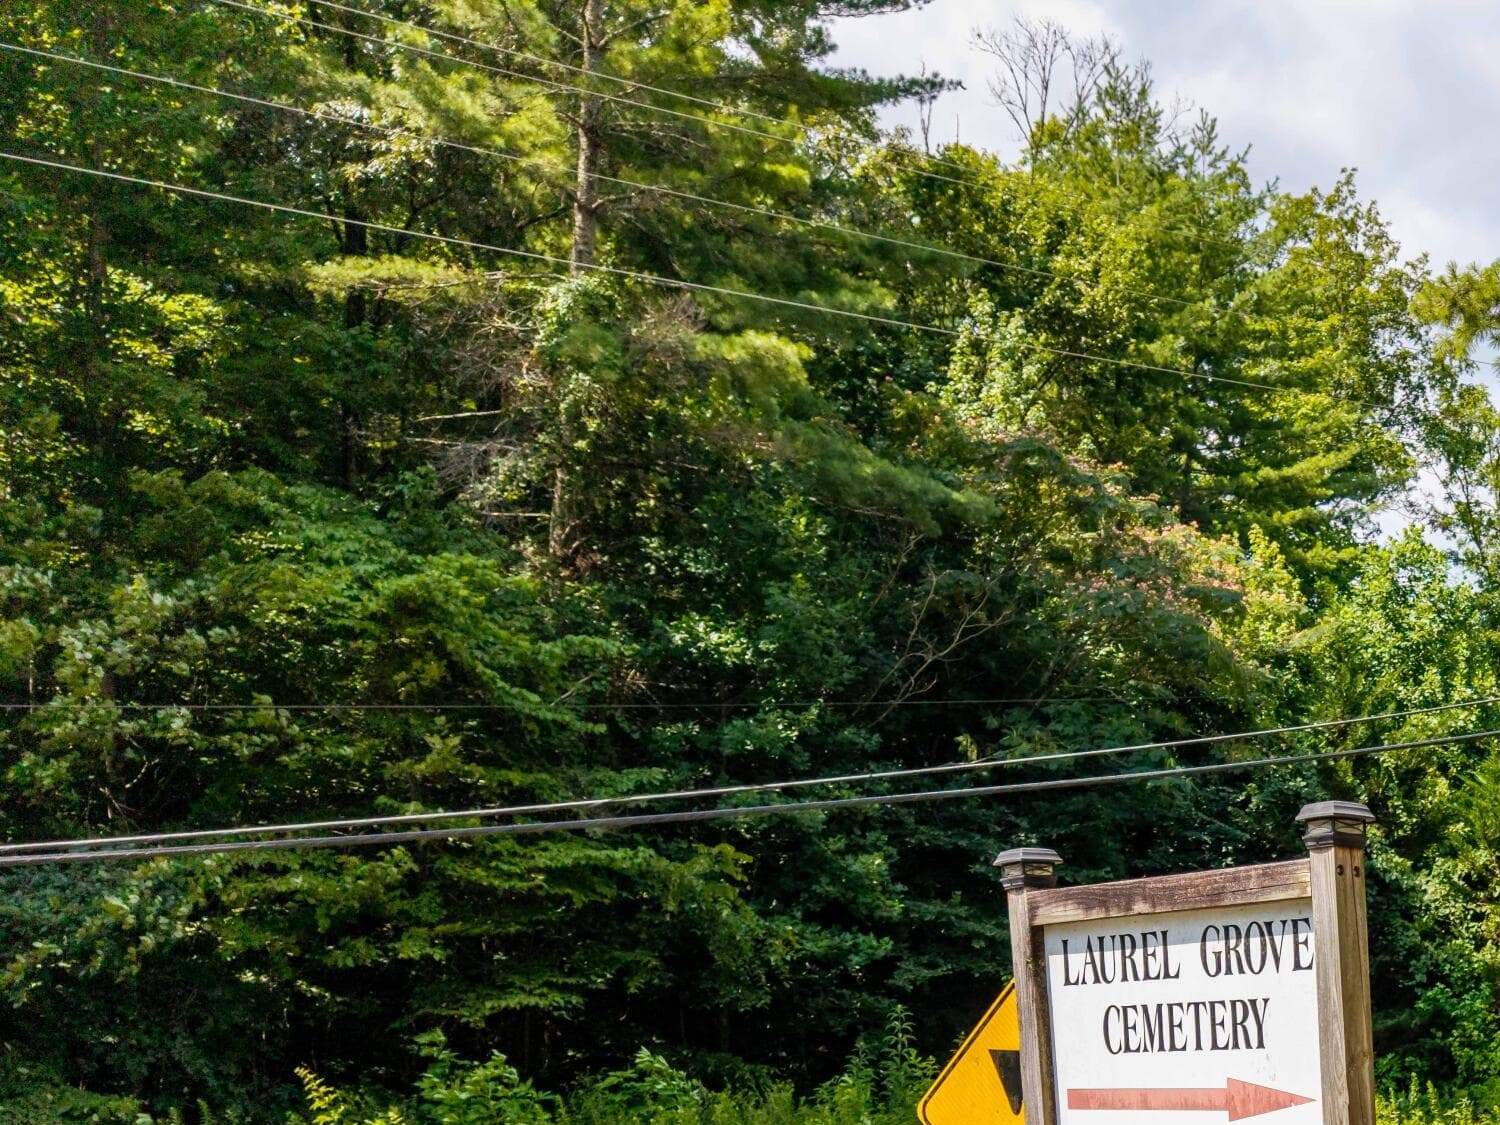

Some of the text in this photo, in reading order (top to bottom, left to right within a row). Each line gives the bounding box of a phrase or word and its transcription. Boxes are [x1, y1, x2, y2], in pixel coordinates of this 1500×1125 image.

[1061, 917, 1314, 986] LAUREL GROVE
[1103, 998, 1270, 1054] CEMETERY
